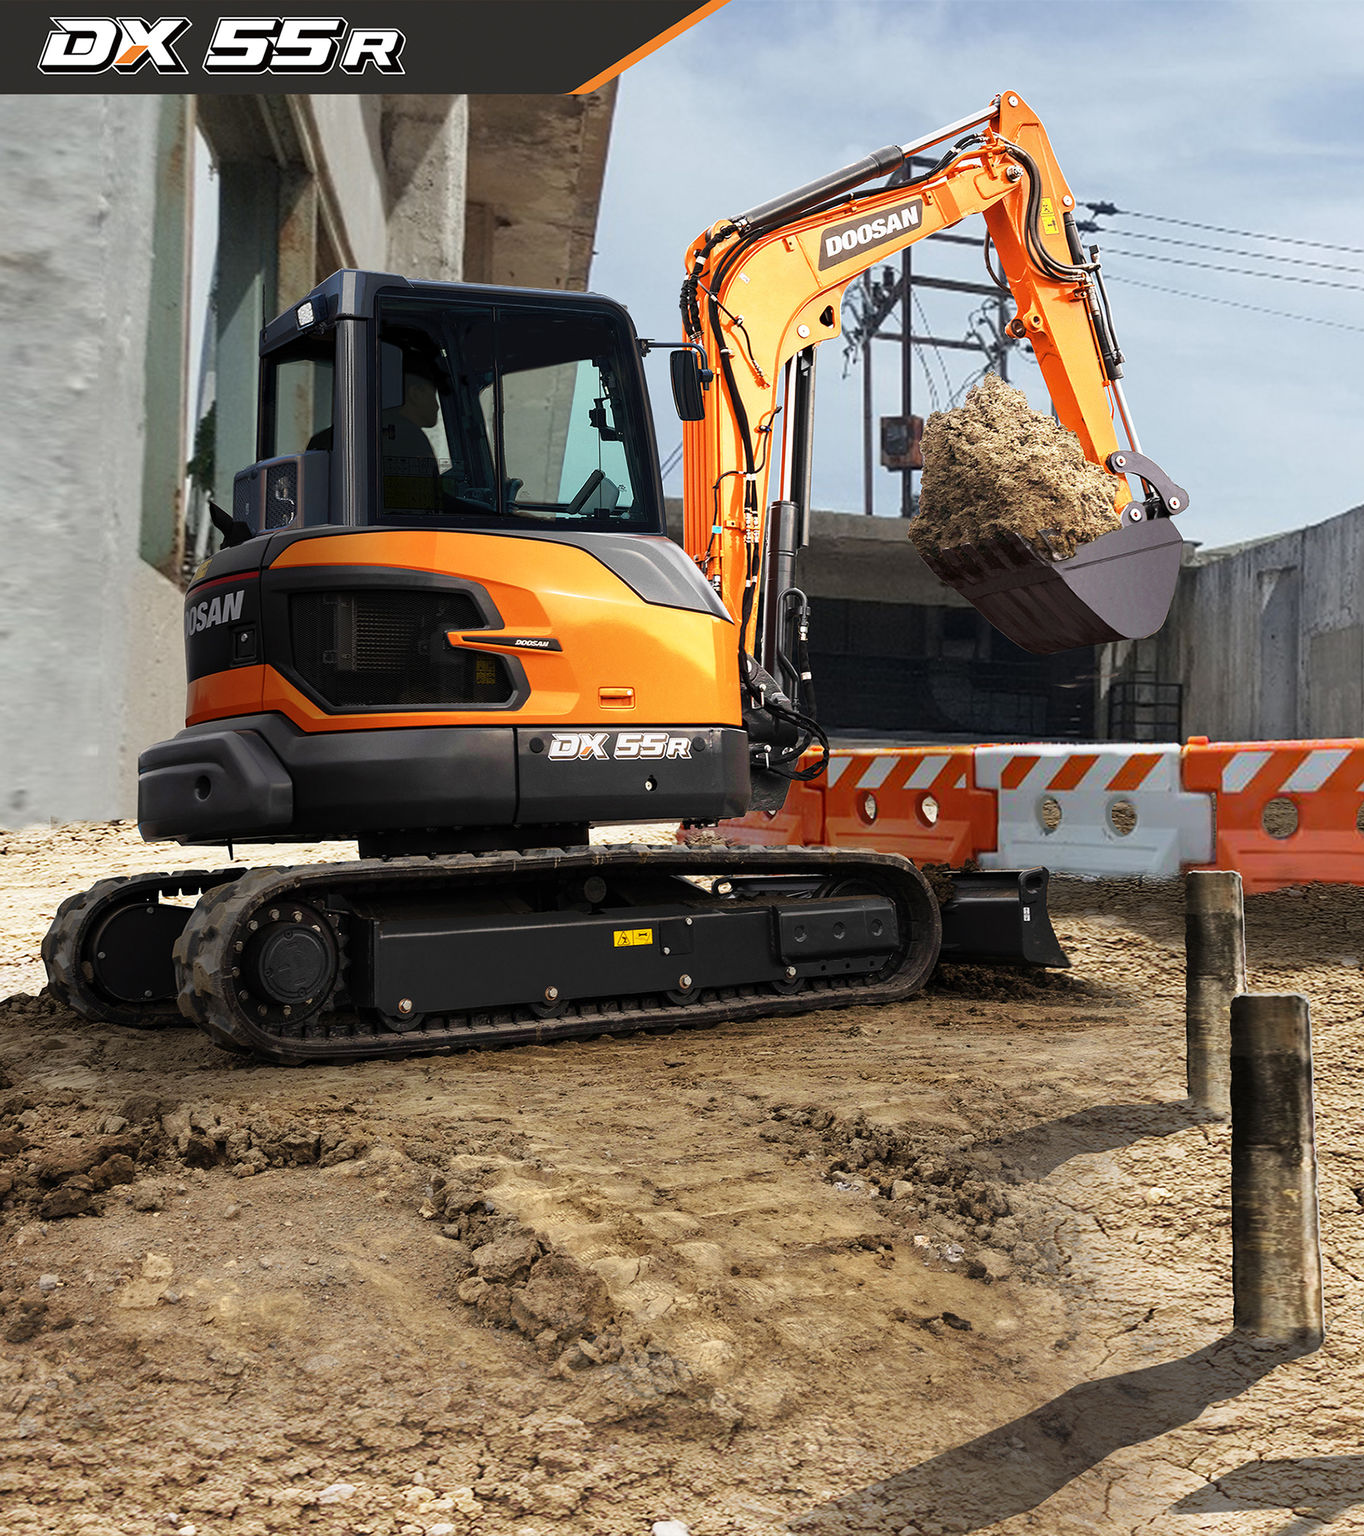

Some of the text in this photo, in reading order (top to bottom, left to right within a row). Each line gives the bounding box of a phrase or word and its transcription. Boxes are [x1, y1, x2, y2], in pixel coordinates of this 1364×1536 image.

[825, 205, 919, 258] DOOSAN
[515, 639, 549, 647] DOOSAN
[548, 732, 692, 761] DX 55R
